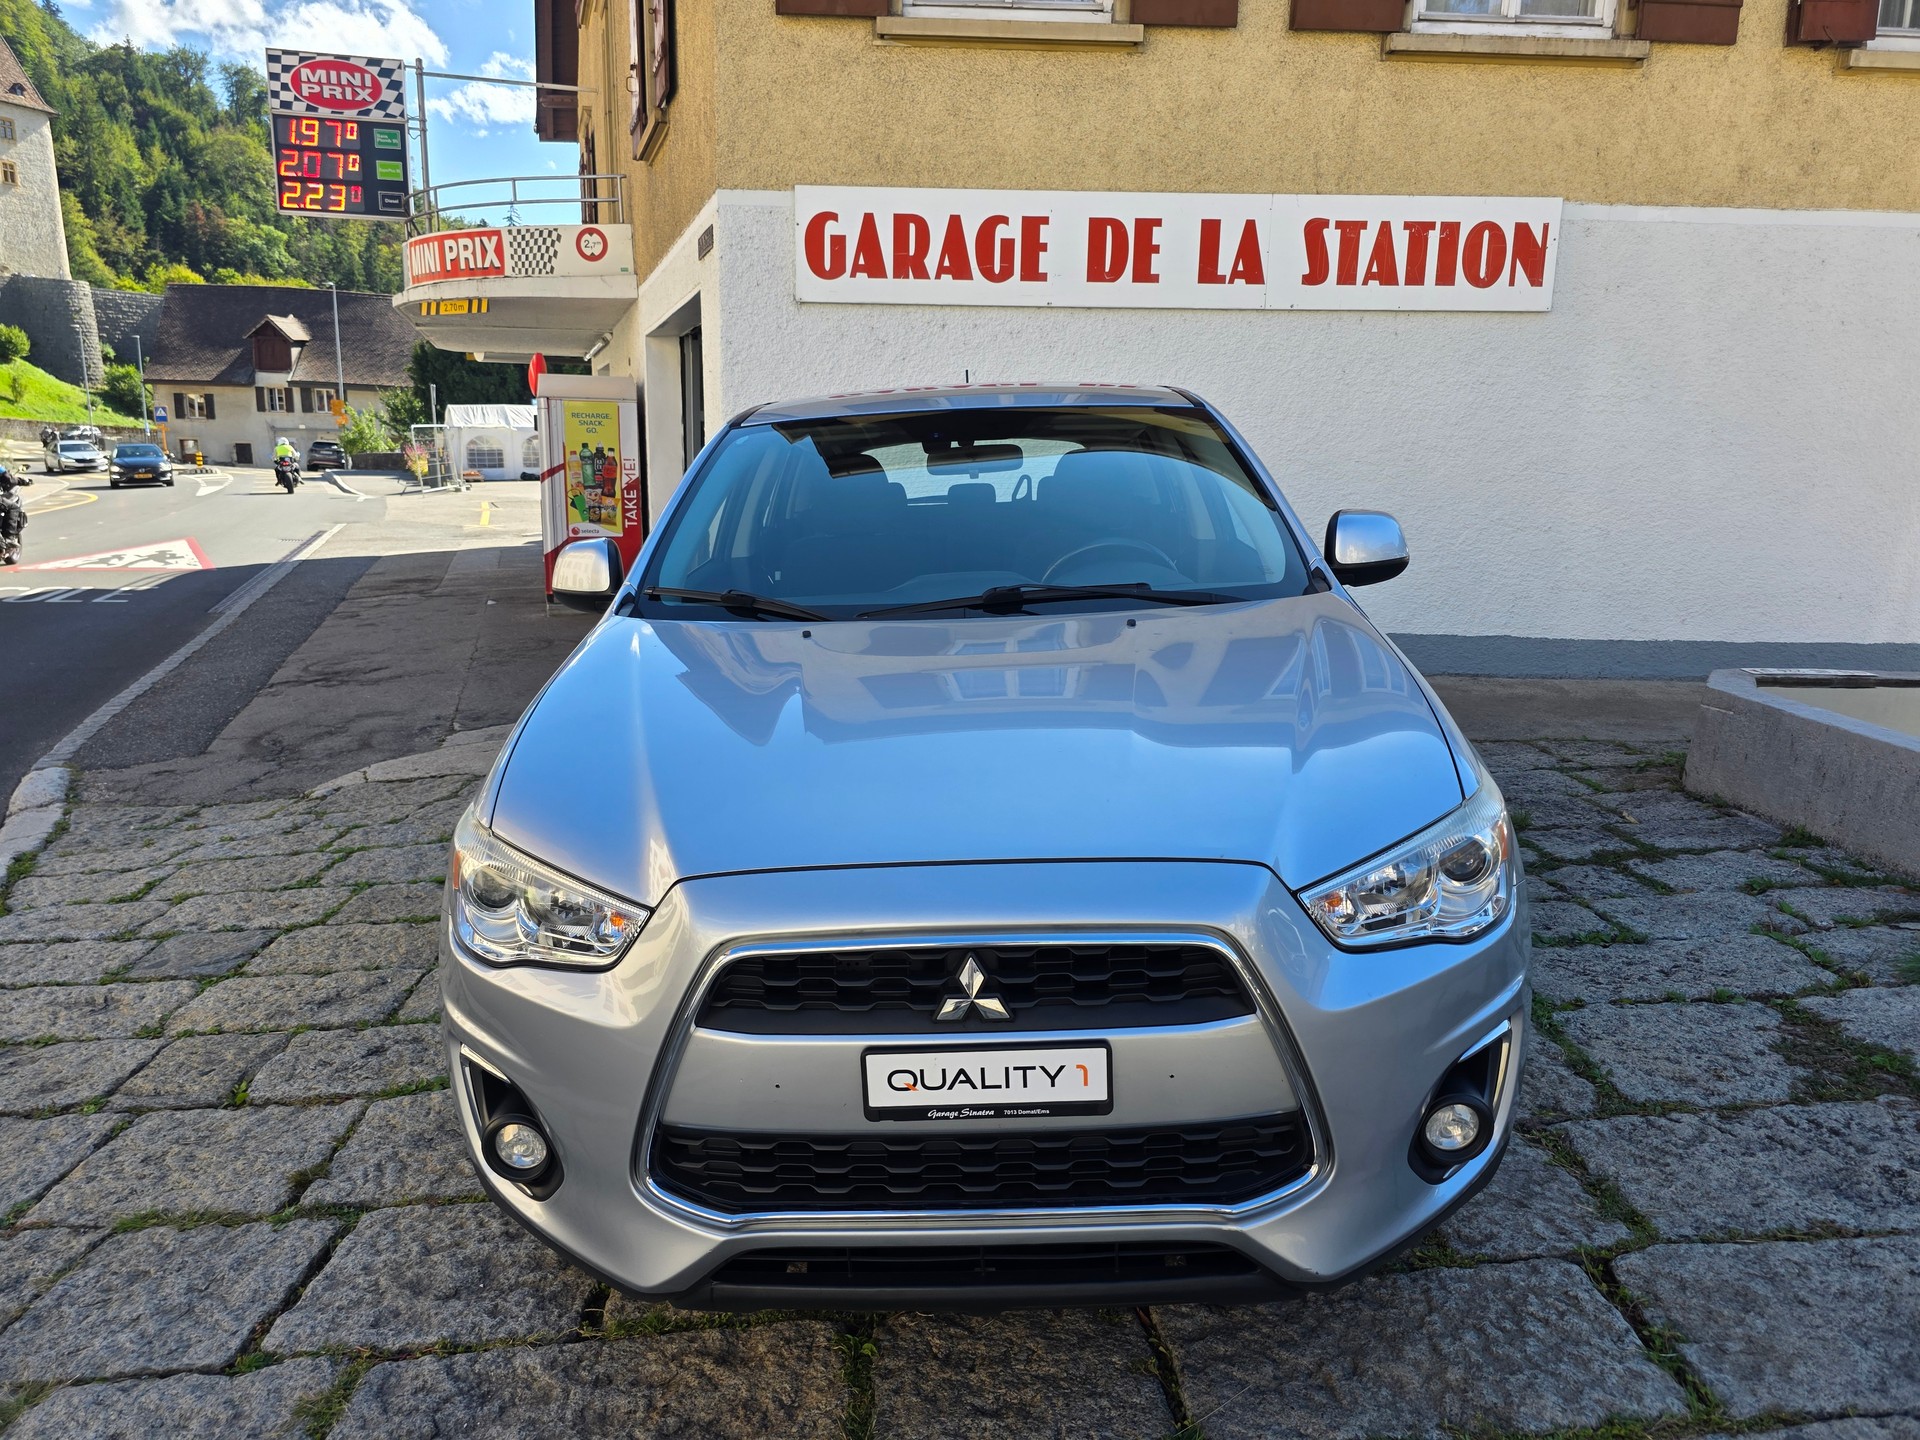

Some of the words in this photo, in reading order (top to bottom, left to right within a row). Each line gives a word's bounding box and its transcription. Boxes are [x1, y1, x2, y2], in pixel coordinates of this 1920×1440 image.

[300, 68, 372, 87] MINI
[301, 83, 374, 102] PRIX
[411, 241, 440, 276] MINI
[444, 235, 501, 271] PRIX
[805, 212, 1048, 282] GARAGE
[1087, 218, 1162, 282] DE
[1198, 219, 1264, 284] LA
[1303, 219, 1548, 287] STATION
[623, 458, 637, 487] ME!
[624, 489, 638, 528] TAKE
[887, 1064, 1066, 1092] QUALITY
[1075, 1064, 1089, 1087] 1
[927, 1109, 958, 1119] Garage
[959, 1108, 995, 1118] Sinatra
